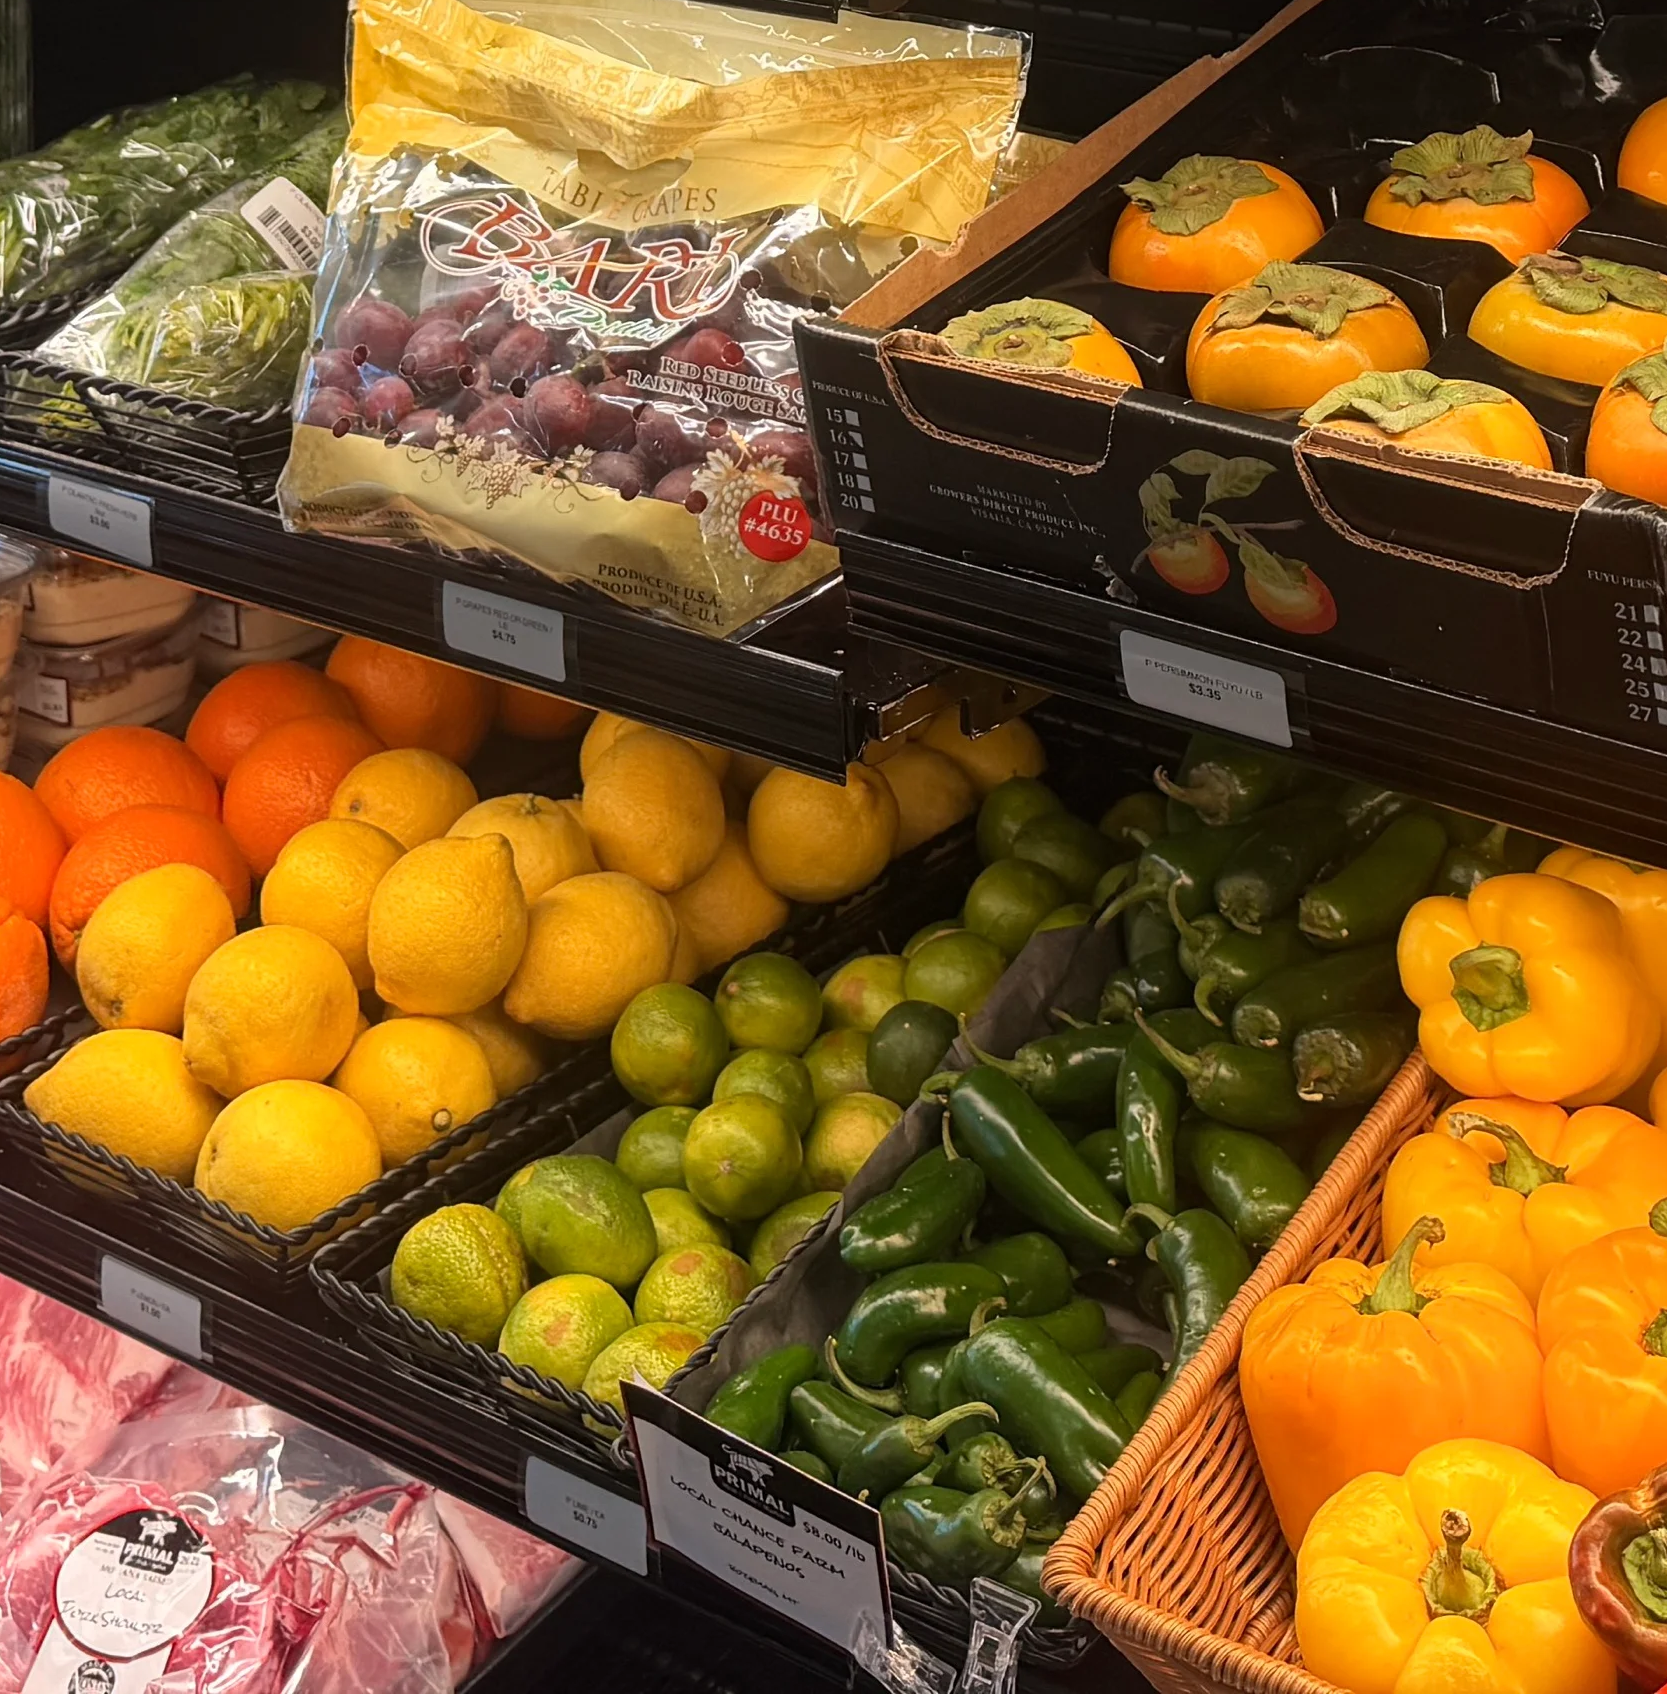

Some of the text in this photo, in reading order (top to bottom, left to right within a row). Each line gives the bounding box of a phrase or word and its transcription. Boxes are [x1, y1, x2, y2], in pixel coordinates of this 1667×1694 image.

[632, 187, 719, 224] GRAPES
[300, 225, 323, 250] $3.00
[659, 355, 791, 400] RED SEEDLESS
[625, 369, 774, 416] RAISINS ROUGE
[812, 379, 850, 399] PRODUCE
[826, 407, 843, 424] 15
[829, 428, 847, 446] 16
[833, 450, 850, 466] 17
[837, 471, 855, 488] 18
[840, 492, 859, 510] 20
[929, 483, 1076, 530] GROWERS DIRECT PRODUCE
[976, 482, 1049, 512] MARKETED BY
[758, 500, 799, 525] PLU
[743, 516, 804, 546] #4635
[1017, 517, 1033, 532] CA
[598, 563, 663, 589] PRODUCE
[684, 587, 723, 609] U.S.A.
[1587, 569, 1620, 585] FUYU
[1614, 601, 1638, 622] 21
[491, 628, 518, 647] $4.75
[1617, 627, 1644, 648] 22
[1621, 652, 1647, 674] 24
[1154, 661, 1264, 700] PERSIMMON FUYU LB
[1188, 682, 1223, 701] $3.35
[1624, 677, 1650, 698] 25
[1628, 702, 1652, 722] 27
[713, 1463, 790, 1517] PRIMAL
[573, 1509, 599, 1530] $0.75
[669, 1473, 846, 1580] LOCAL CHANCE FARM
[713, 1521, 806, 1582] JALAPENOS
[802, 1520, 867, 1564] $8.00 /lb
[122, 1541, 174, 1567] PRIMAL
